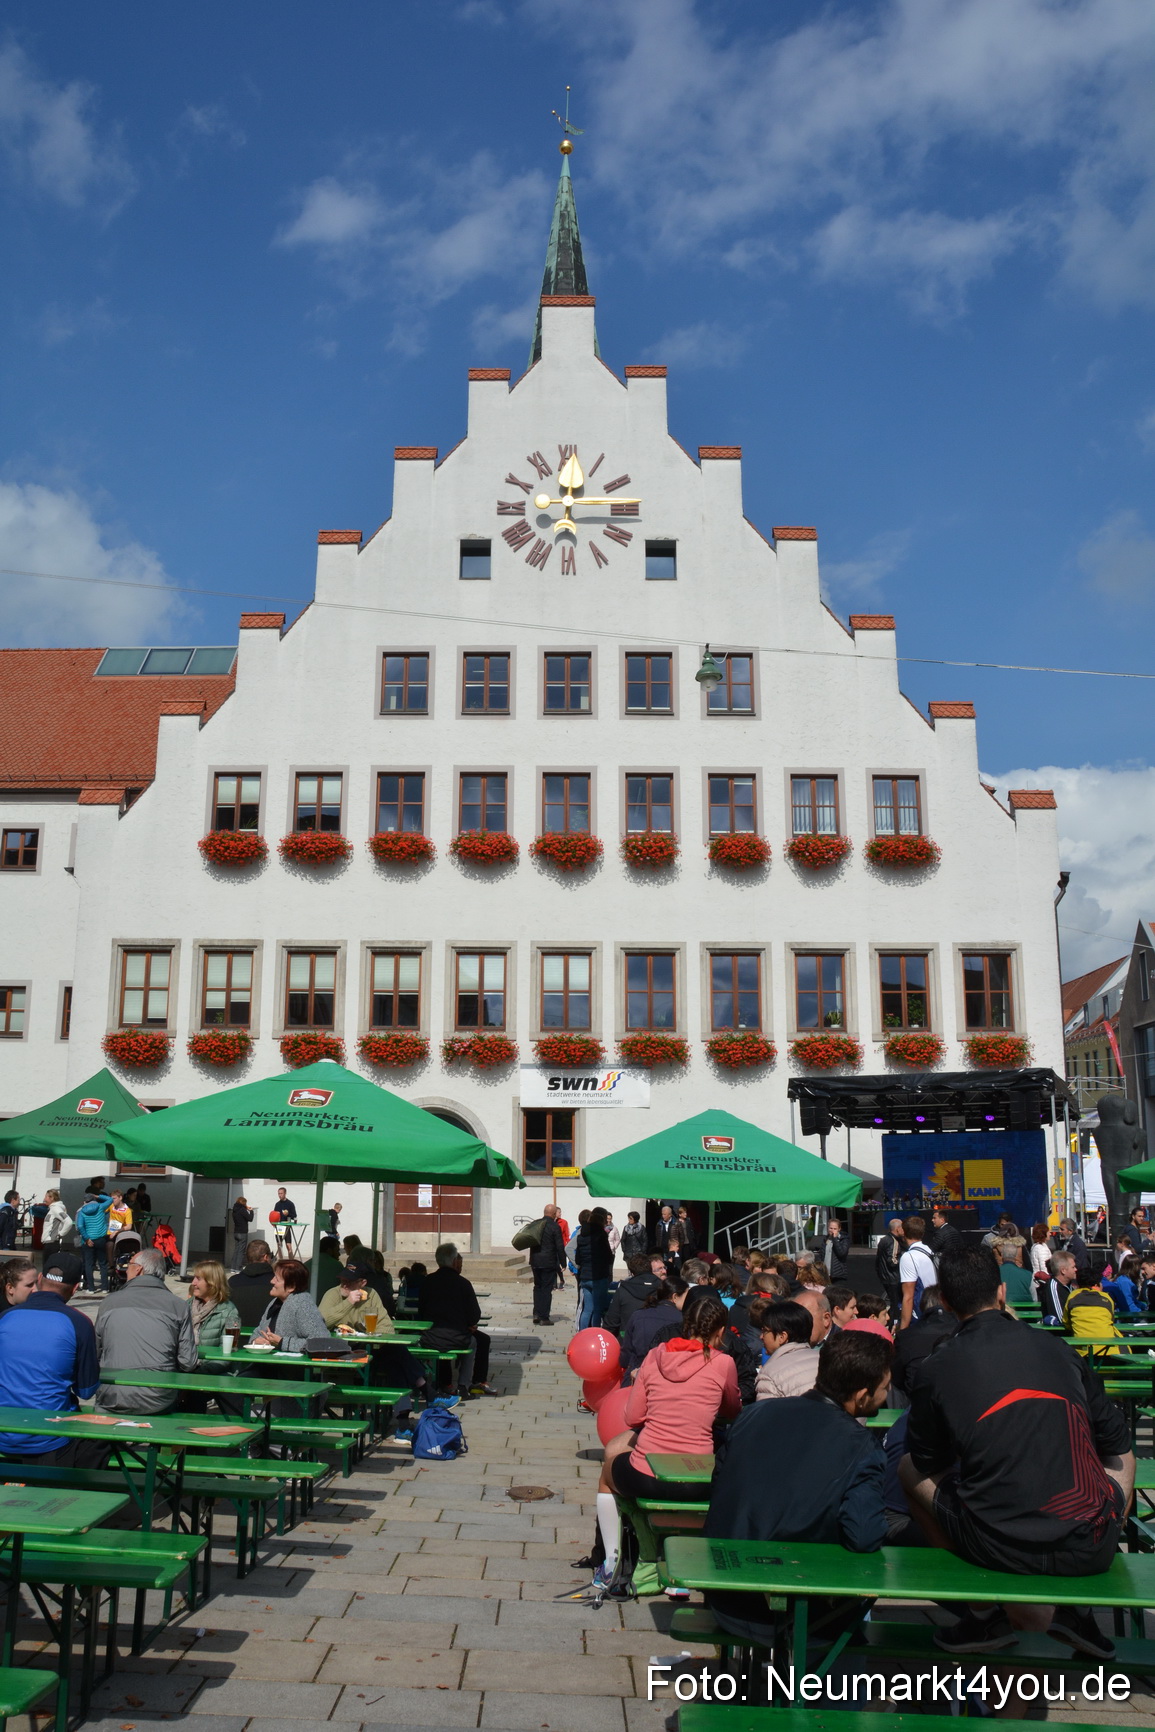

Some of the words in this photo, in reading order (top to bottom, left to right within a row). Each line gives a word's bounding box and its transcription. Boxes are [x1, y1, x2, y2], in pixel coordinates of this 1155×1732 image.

[505, 472, 535, 495] X
[588, 540, 609, 569] V
[547, 1076, 599, 1091] swn
[54, 1115, 114, 1125] Neumarkter
[250, 1111, 358, 1122] Neumarkter
[39, 1120, 108, 1130] Lammsbr
[223, 1118, 374, 1133] Lammsbräu
[679, 1154, 761, 1164] Neumarkter
[664, 1160, 777, 1173] Lammsbräu
[967, 1187, 1001, 1197] KANN
